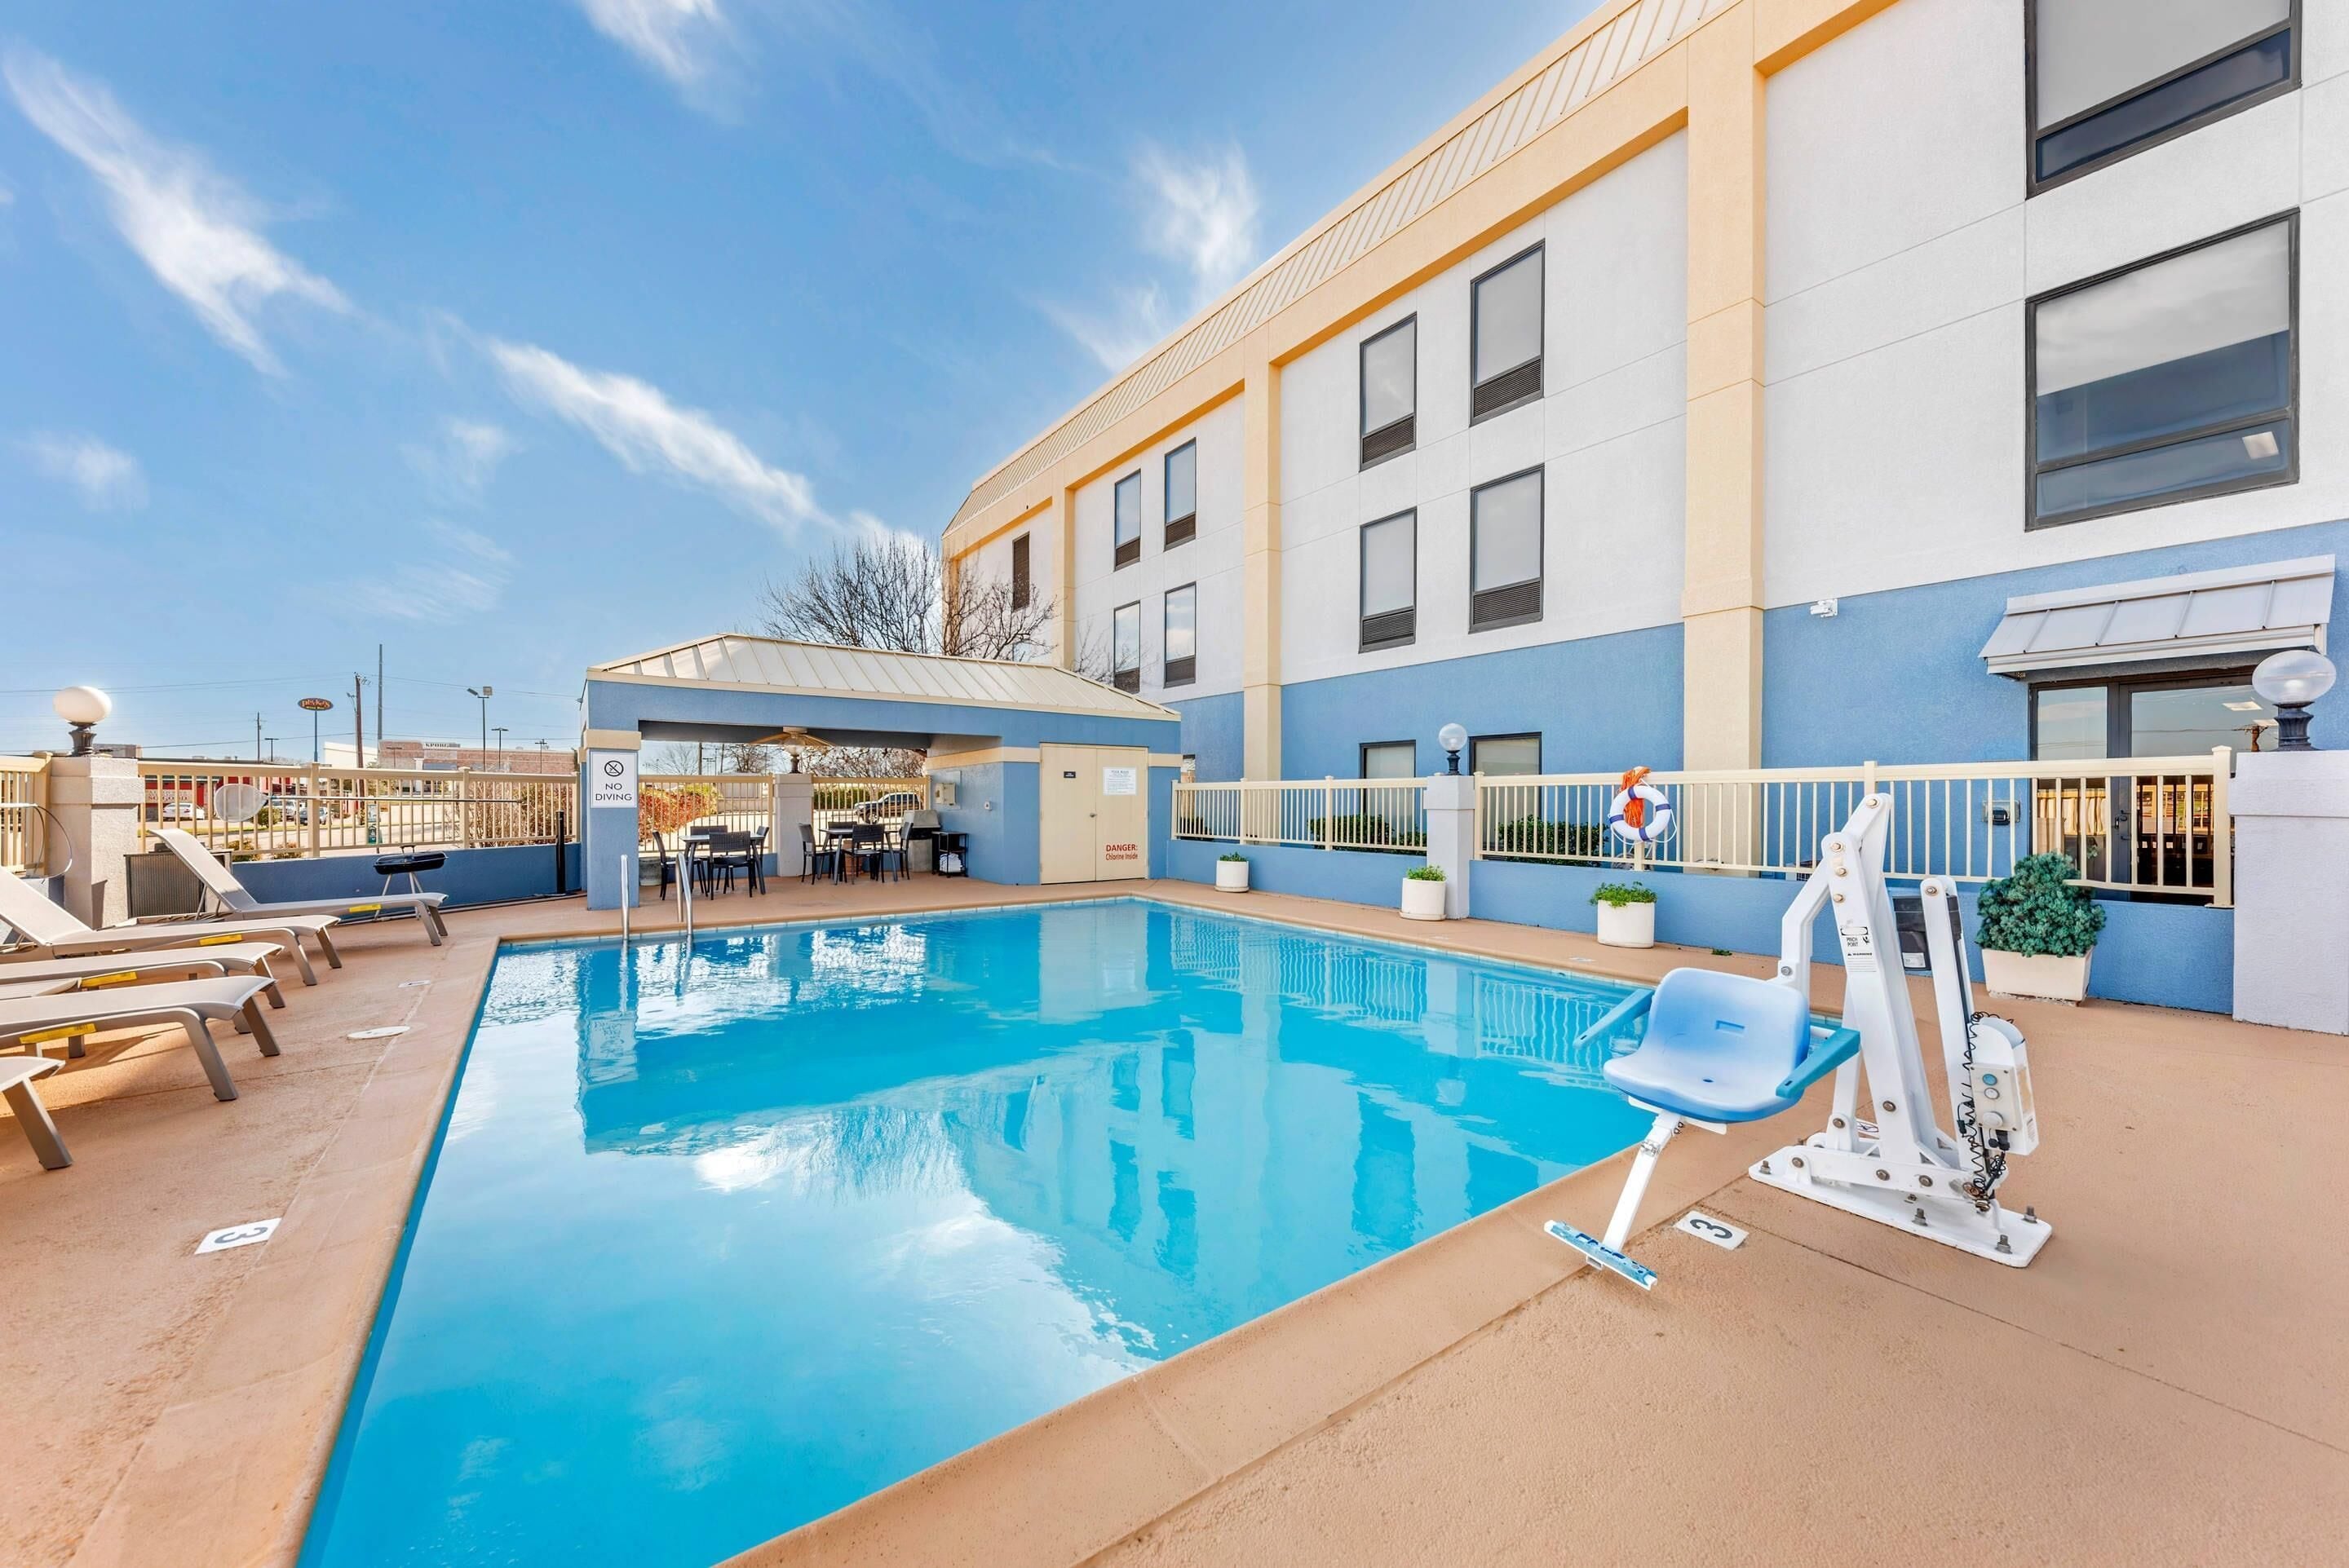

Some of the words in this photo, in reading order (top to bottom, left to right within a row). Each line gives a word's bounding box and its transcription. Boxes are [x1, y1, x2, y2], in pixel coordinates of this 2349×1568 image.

[1106, 843, 1139, 852] DANGER:
[1105, 853, 1124, 861] Chlorine
[215, 1226, 268, 1243] 3
[1689, 1218, 1733, 1239] 3
